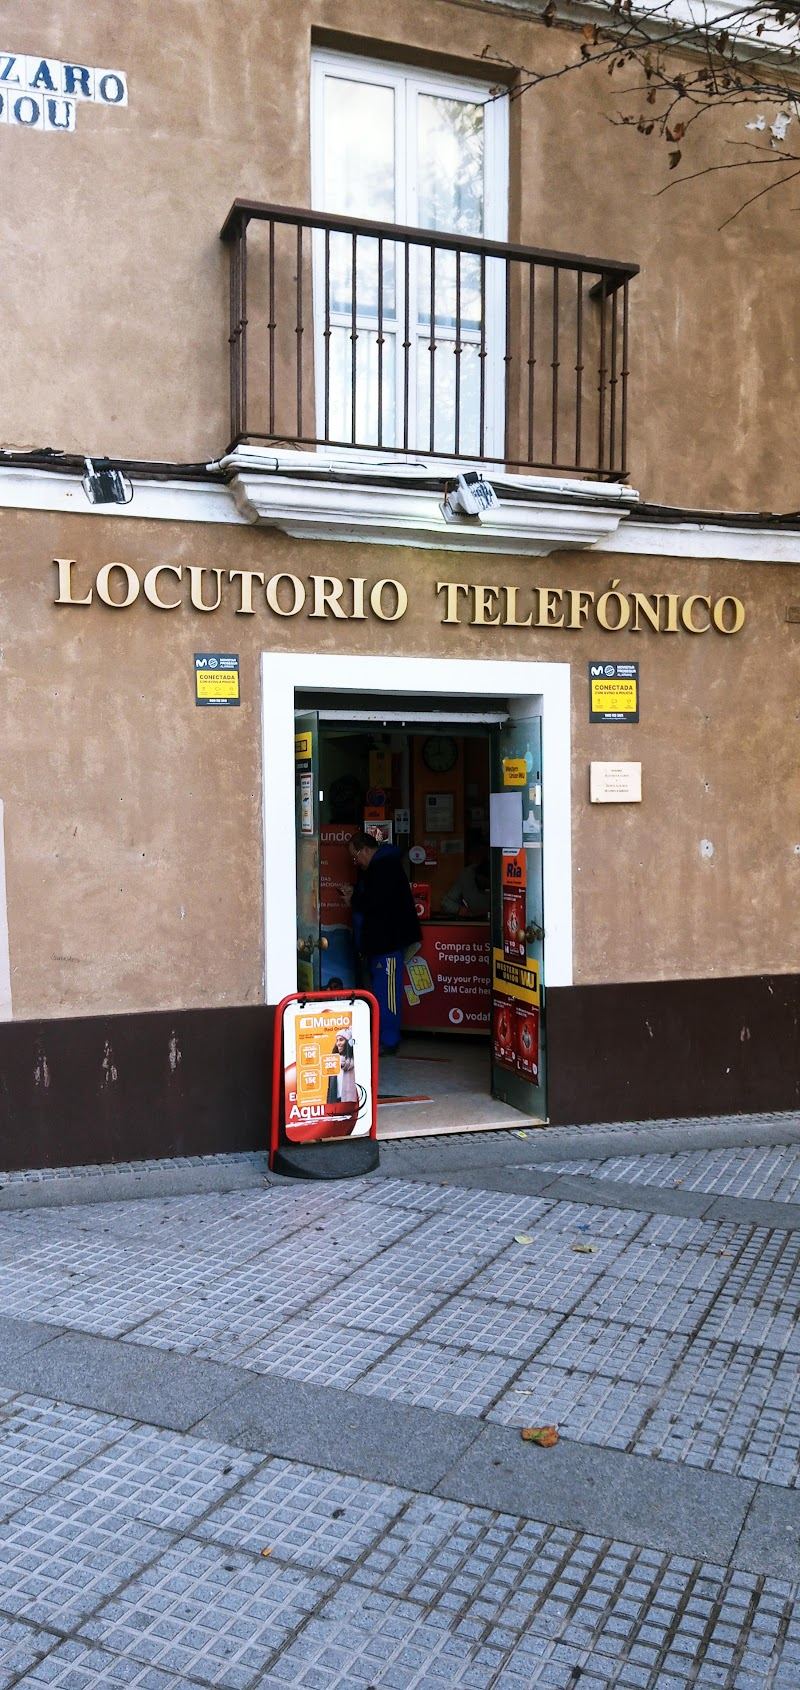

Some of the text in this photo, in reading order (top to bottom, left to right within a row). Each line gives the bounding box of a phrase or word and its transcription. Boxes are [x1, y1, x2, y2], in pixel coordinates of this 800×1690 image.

[0, 93, 73, 128] OU
[53, 558, 745, 634] LOCUTORIO TELEFÓNICO
[507, 860, 522, 878] Ria
[435, 941, 471, 952] Compra
[472, 943, 482, 951] tu
[439, 952, 477, 964] Prepago
[437, 974, 452, 983] Buy
[453, 976, 471, 984] your
[443, 985, 458, 993] SIM
[459, 986, 477, 994] Card
[313, 1016, 350, 1028] Mundo
